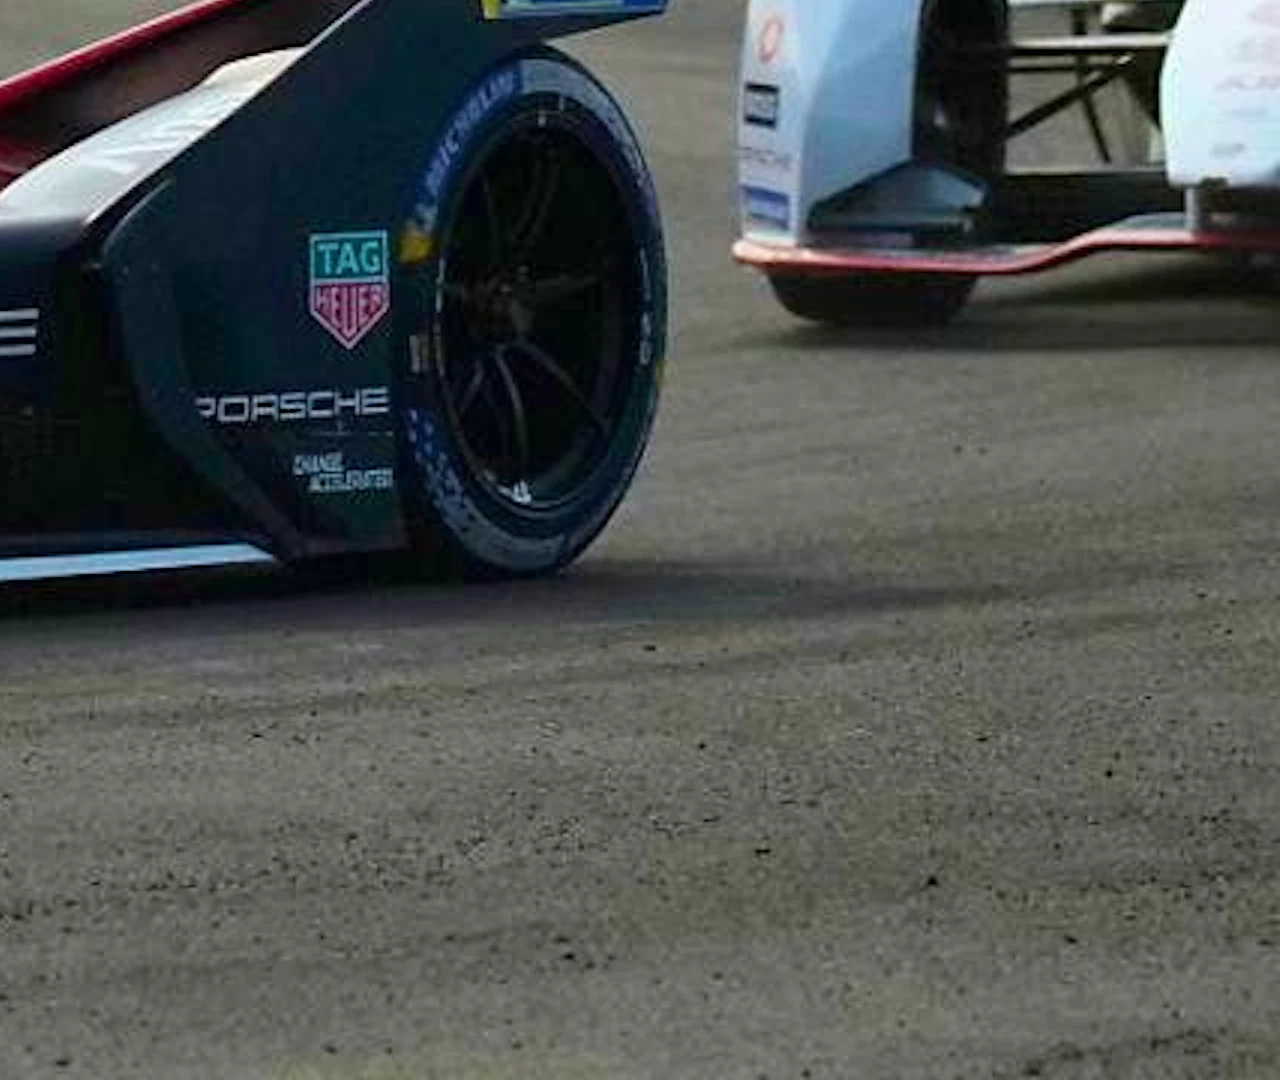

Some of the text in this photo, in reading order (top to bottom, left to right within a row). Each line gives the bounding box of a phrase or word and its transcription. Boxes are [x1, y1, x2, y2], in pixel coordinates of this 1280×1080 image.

[317, 241, 383, 275] TAG
[314, 282, 383, 342] HEUER
[195, 385, 390, 422] PORSCHE
